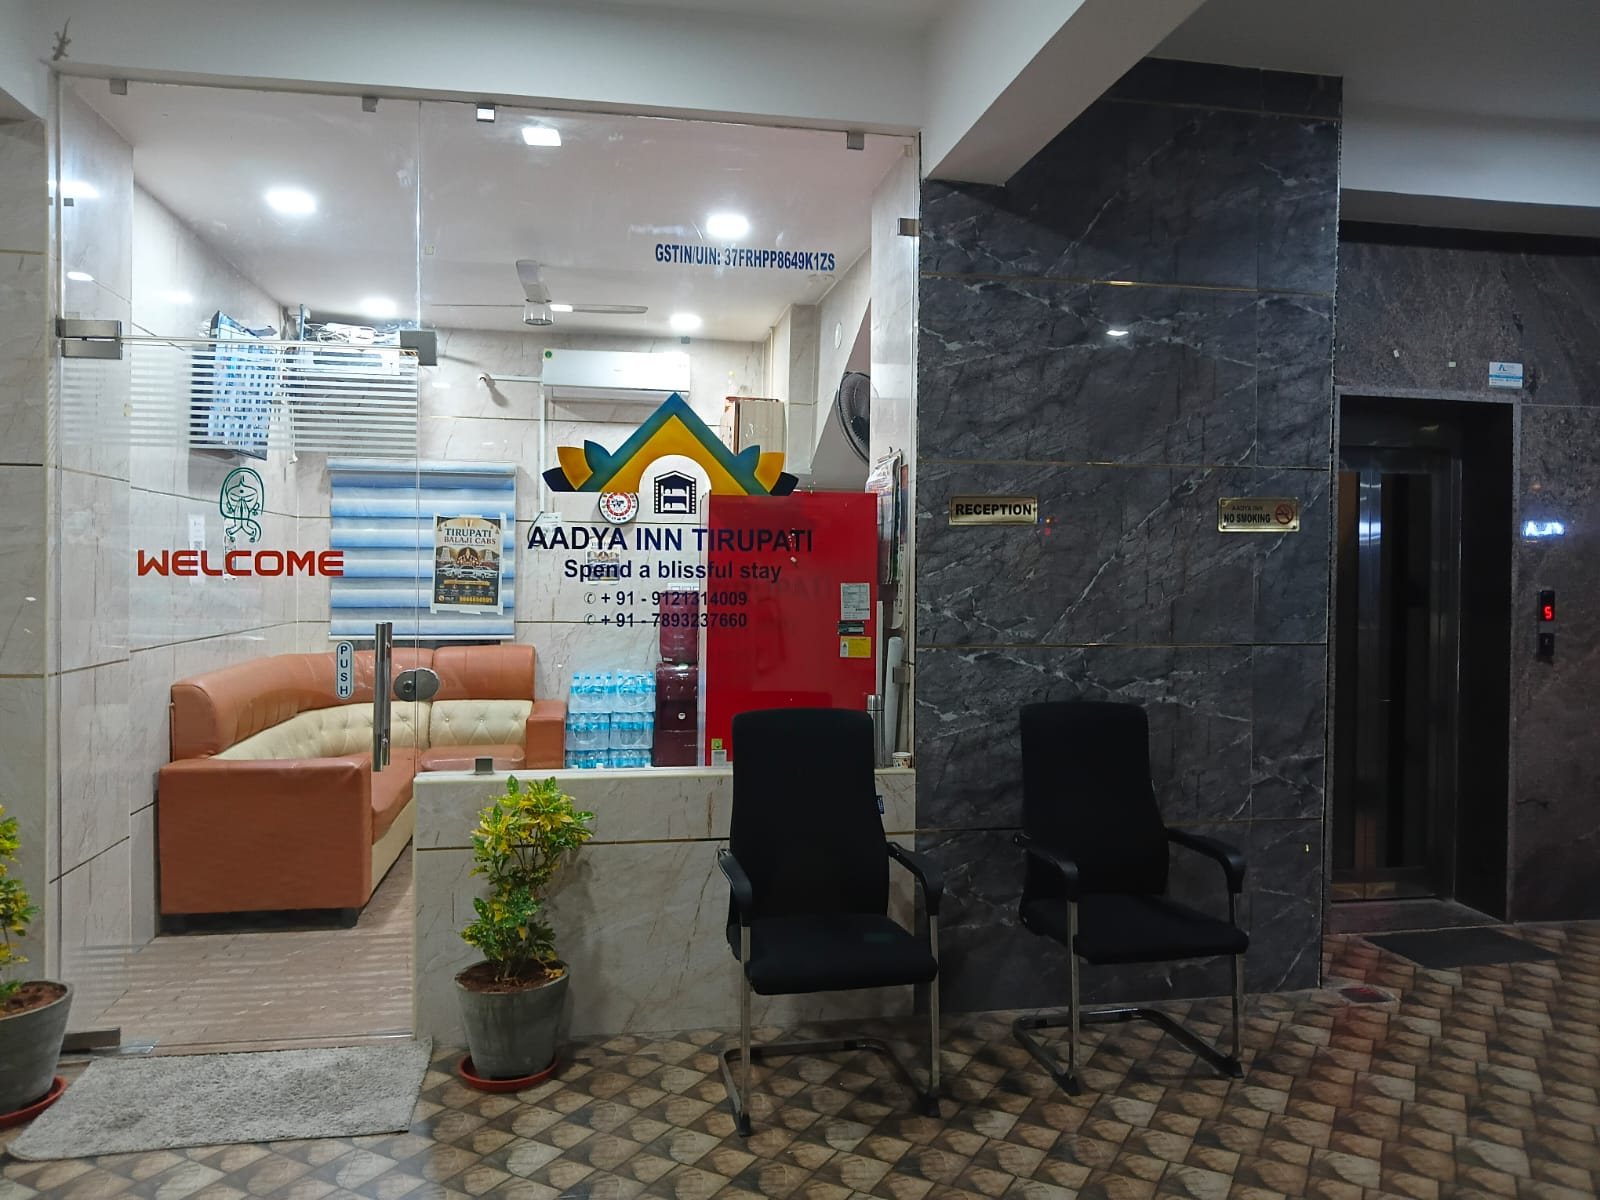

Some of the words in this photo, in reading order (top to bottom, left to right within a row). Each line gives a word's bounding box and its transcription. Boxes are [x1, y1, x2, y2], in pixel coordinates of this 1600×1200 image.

[655, 243, 721, 265] GSTIN/UIN:
[724, 247, 835, 271] 37FRHPP8649K1ZS
[955, 503, 1031, 516] RECEPTION
[1224, 513, 1234, 523] NO
[1236, 514, 1270, 523] SMOKING
[444, 536, 473, 544] BALAJI
[475, 537, 496, 545] CABS
[445, 528, 492, 538] TIRUPATI
[528, 527, 627, 551] AADYA
[636, 528, 681, 551] INN
[692, 528, 813, 552] TIRUPATI
[137, 550, 344, 577] WELCOME
[564, 559, 632, 582] Spend
[640, 564, 650, 578] a
[658, 560, 733, 579] blissful
[740, 563, 782, 583] stay
[616, 591, 634, 605] 91
[651, 591, 747, 606] 9121314009
[616, 613, 634, 627] 91
[651, 613, 747, 628] 7893237660
[340, 645, 348, 695] PUSH
